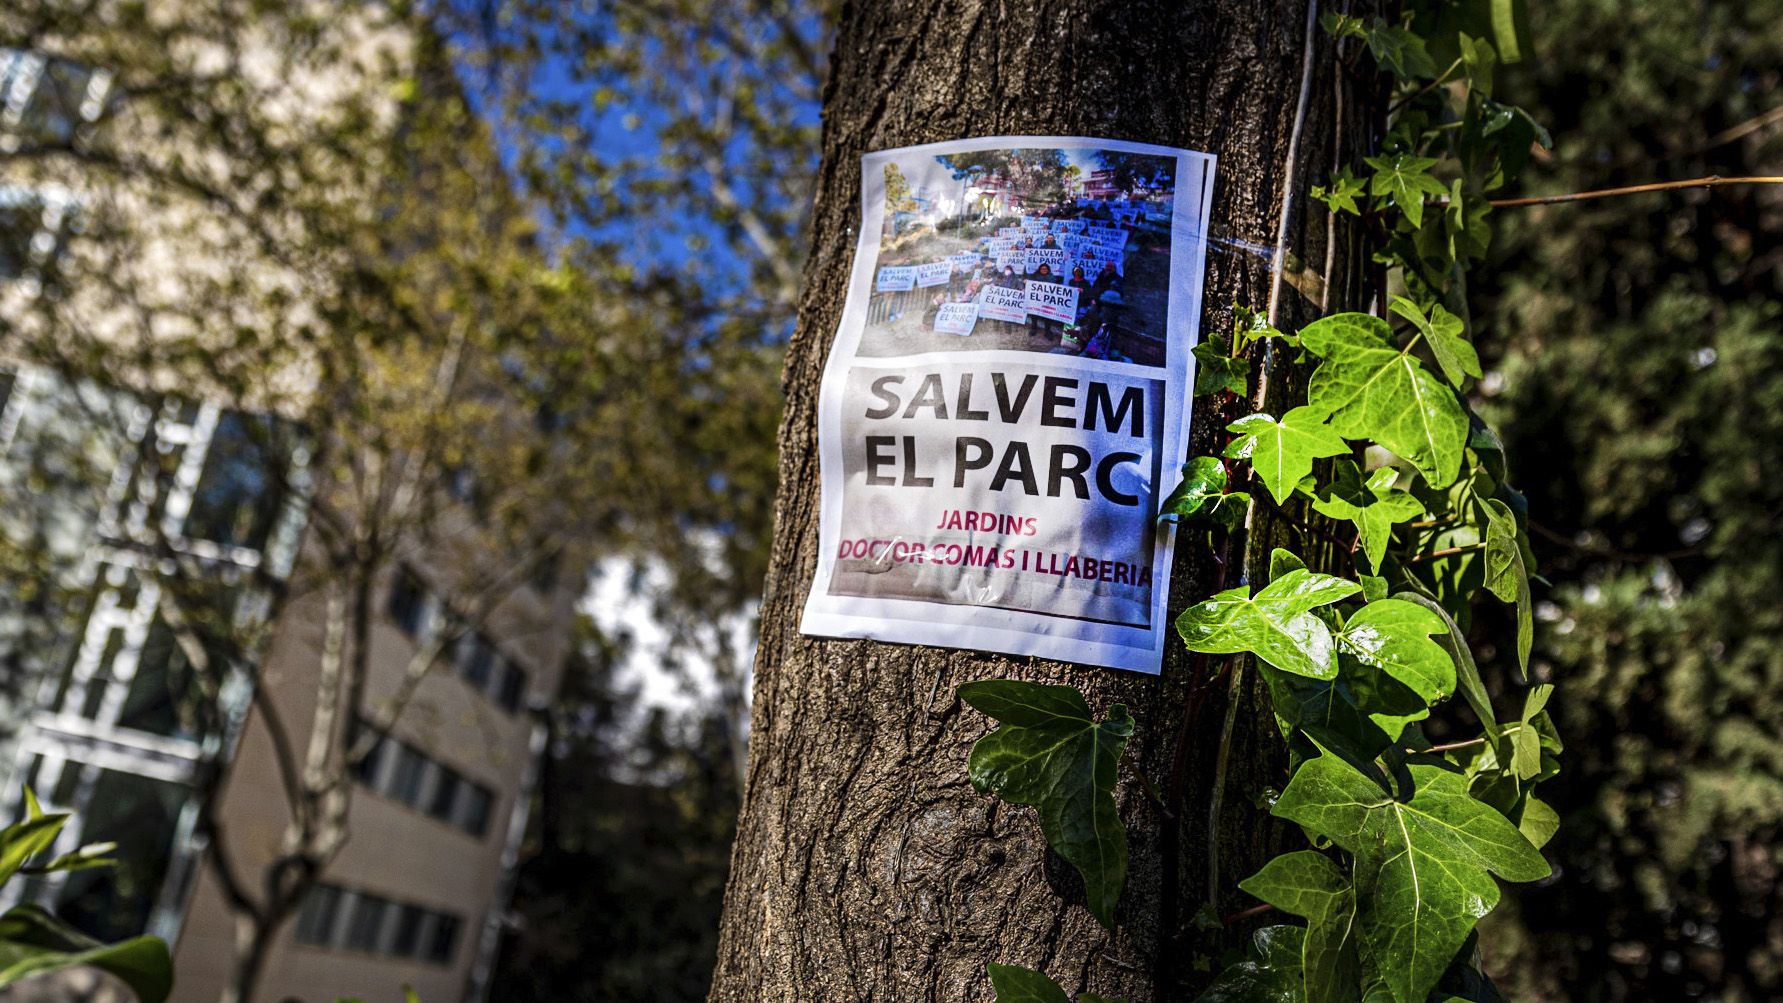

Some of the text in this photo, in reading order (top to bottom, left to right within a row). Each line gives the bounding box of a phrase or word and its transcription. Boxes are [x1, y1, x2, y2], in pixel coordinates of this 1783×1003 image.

[1029, 249, 1064, 258] SALVEM
[1073, 259, 1104, 269] SALVE
[988, 287, 1025, 300] SALVEM
[1031, 283, 1073, 298] SALVEM
[985, 295, 1024, 309] EL PARC
[1030, 292, 1041, 302] EL
[1043, 295, 1072, 308] PARC
[944, 305, 976, 314] SALVEM
[864, 372, 1145, 438] SALVEM
[866, 435, 1143, 507] EL PARC
[937, 508, 1038, 537] JARDINS
[838, 538, 1153, 588] DOCTOR COMAS I LLABERIA
